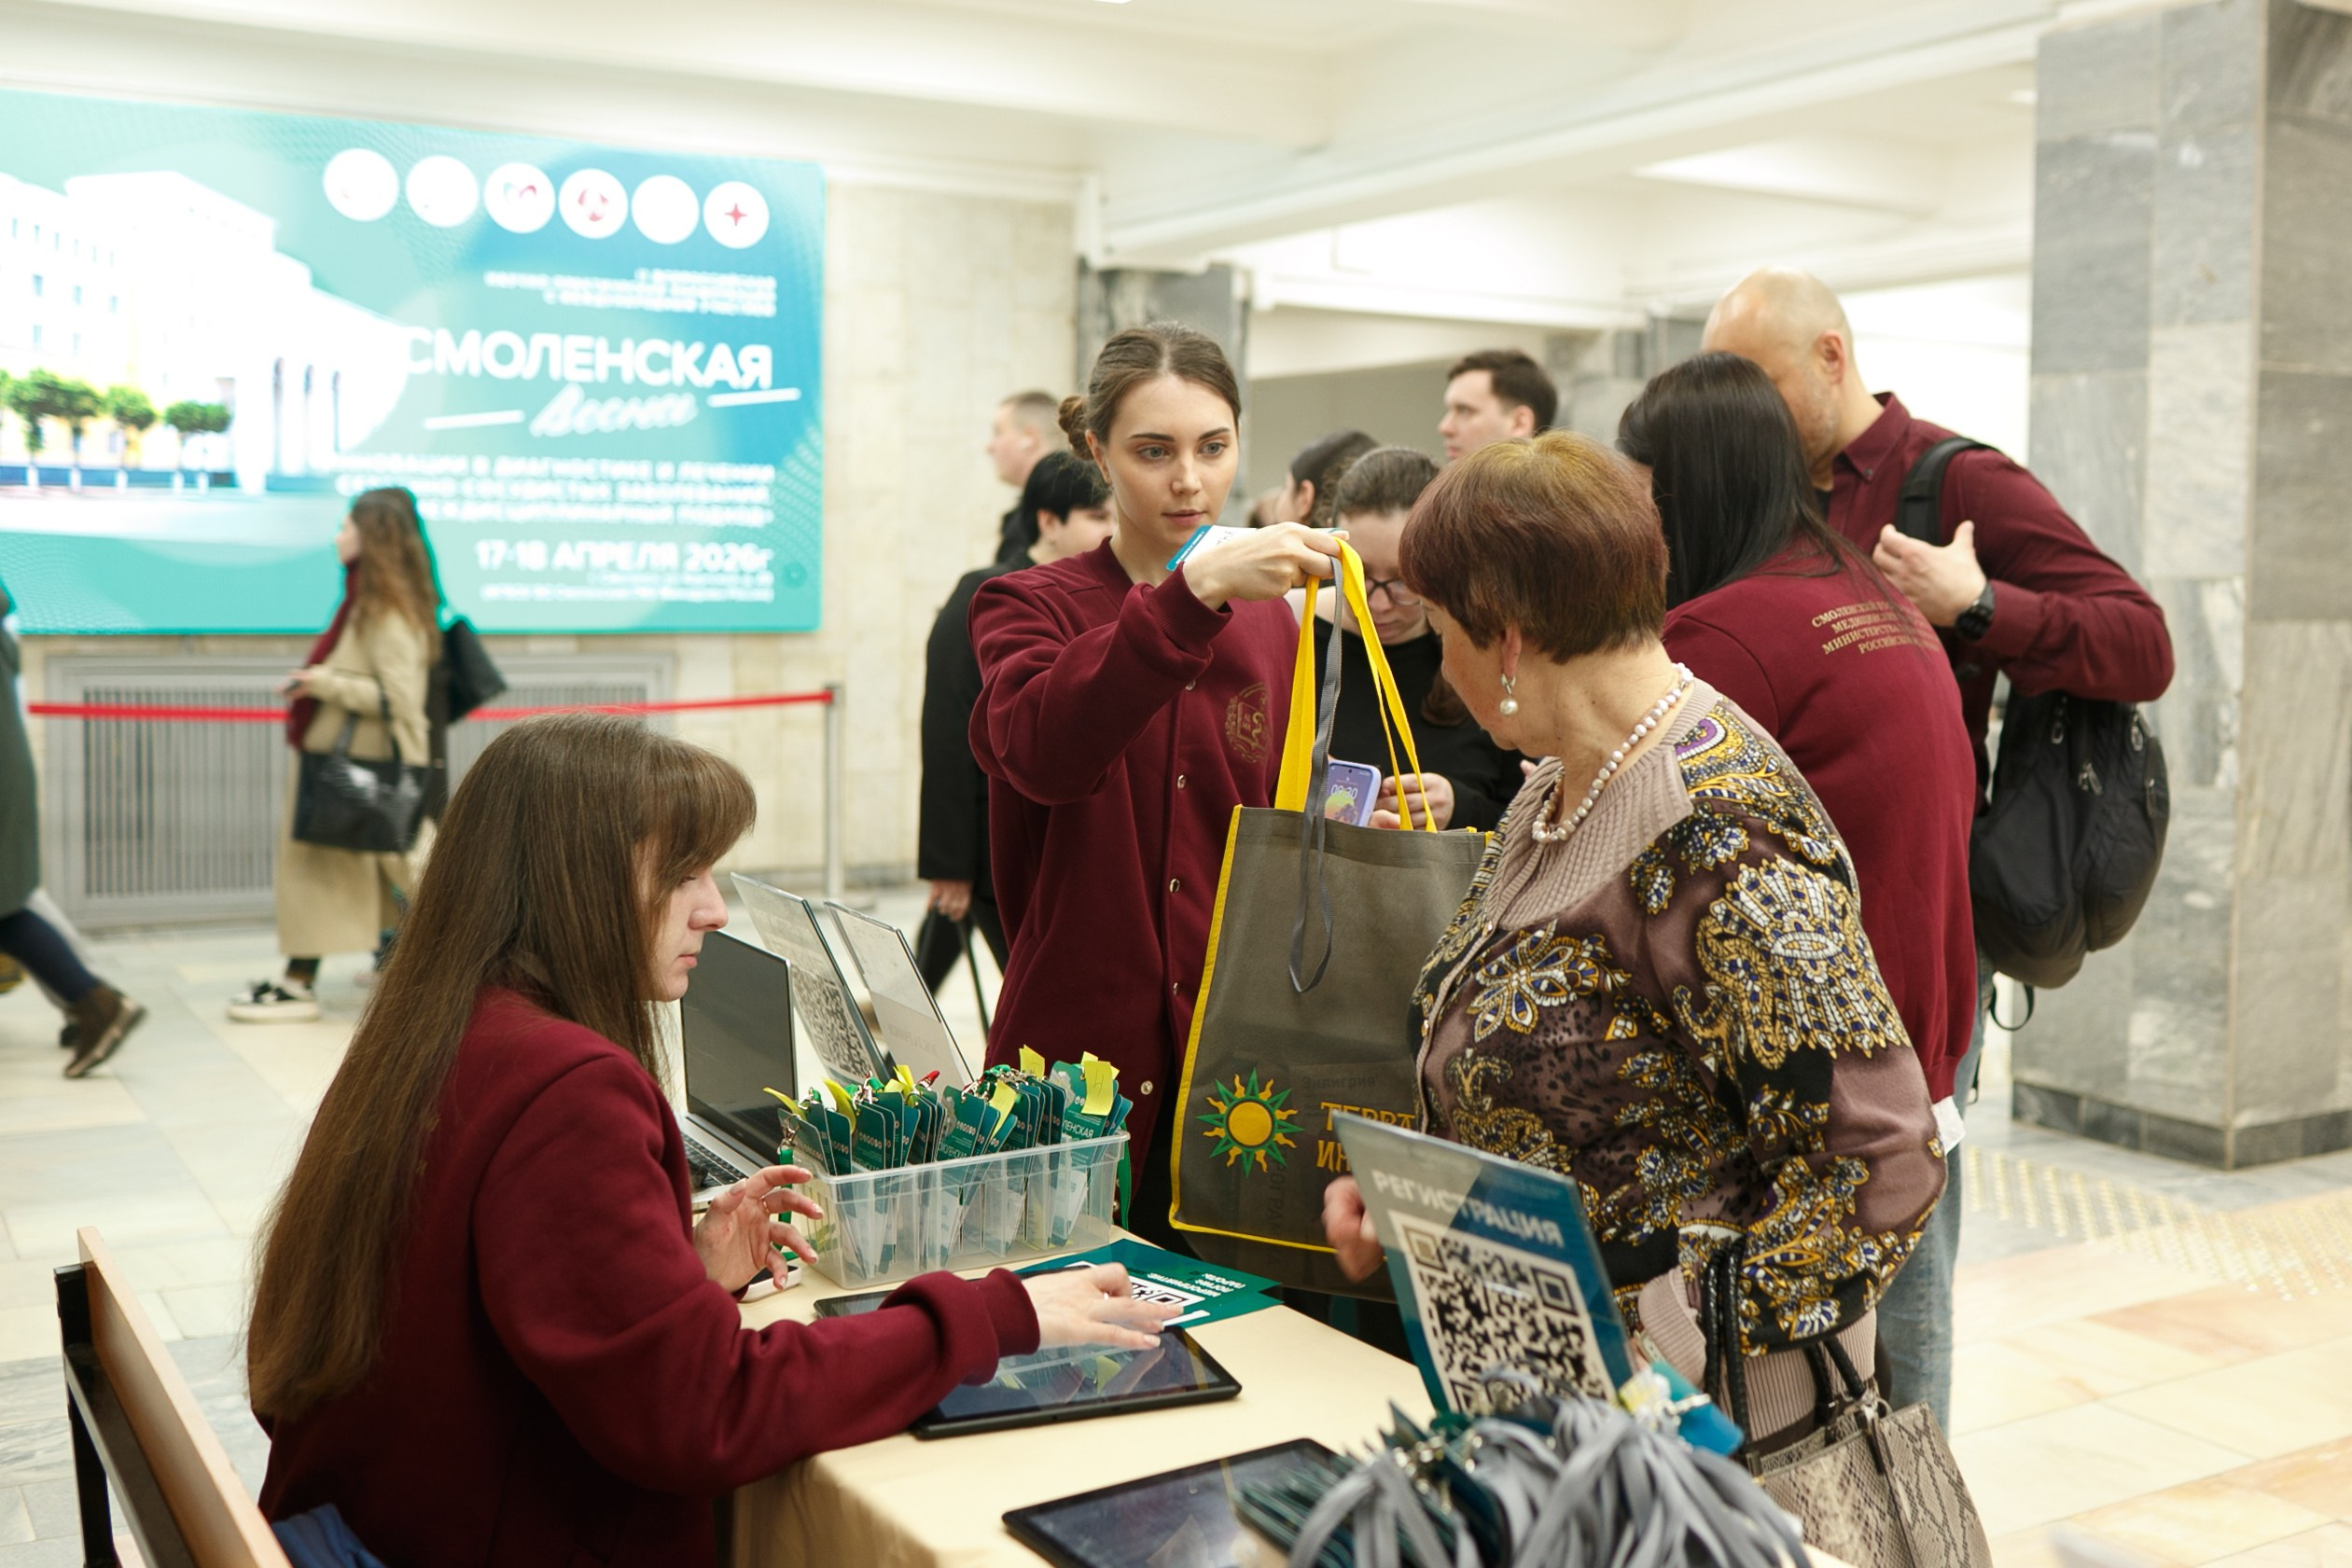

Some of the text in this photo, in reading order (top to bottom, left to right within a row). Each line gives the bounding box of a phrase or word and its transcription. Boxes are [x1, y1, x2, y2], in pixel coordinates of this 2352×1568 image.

[405, 326, 773, 391] СМОЛЕНСКАЯ
[551, 539, 679, 572] АПРЕЛЯ
[1371, 1169, 1566, 1248] РЕГИСТРАЦИЯ
